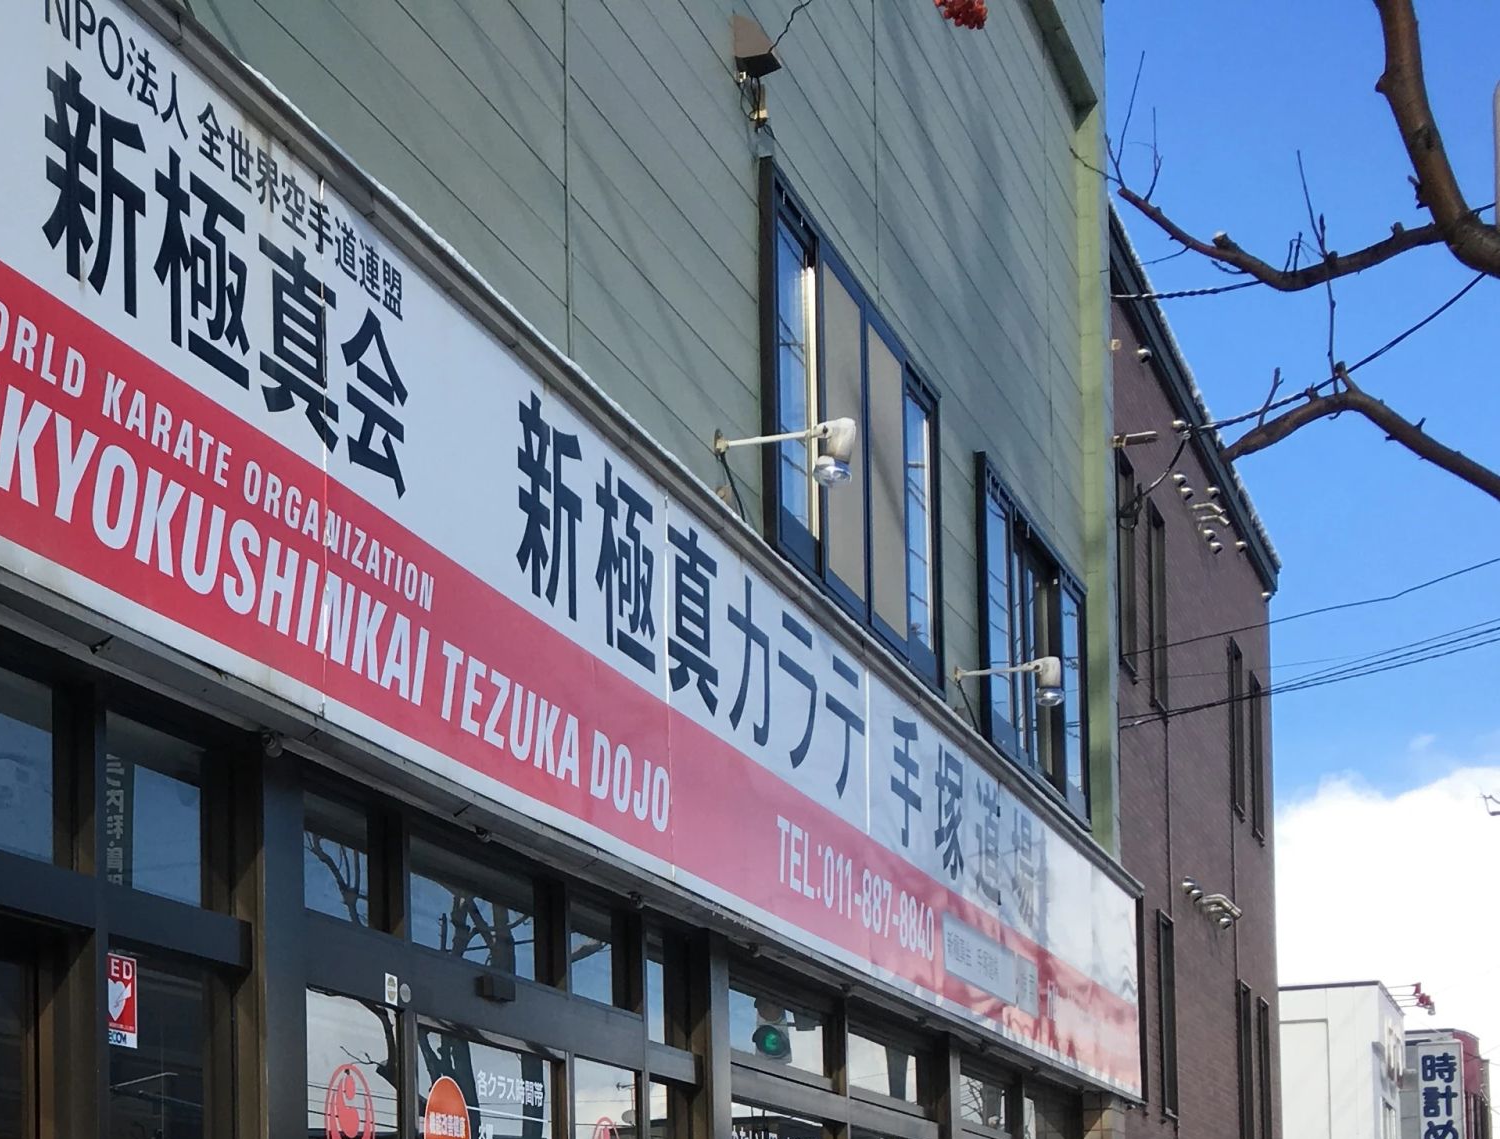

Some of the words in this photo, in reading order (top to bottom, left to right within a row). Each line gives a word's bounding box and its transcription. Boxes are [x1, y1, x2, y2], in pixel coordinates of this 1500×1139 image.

[42, 60, 408, 499] 新極真会
[45, 0, 188, 140] NPO法人
[197, 102, 403, 321] 全世界空手道連盟
[103, 376, 232, 490] KARATE
[243, 462, 435, 612] ORGANIZATION
[441, 642, 581, 789] TEZUKA
[590, 732, 672, 833] DOJO
[516, 389, 866, 799] 新極真カラテ
[891, 716, 1036, 928] 手塚道場
